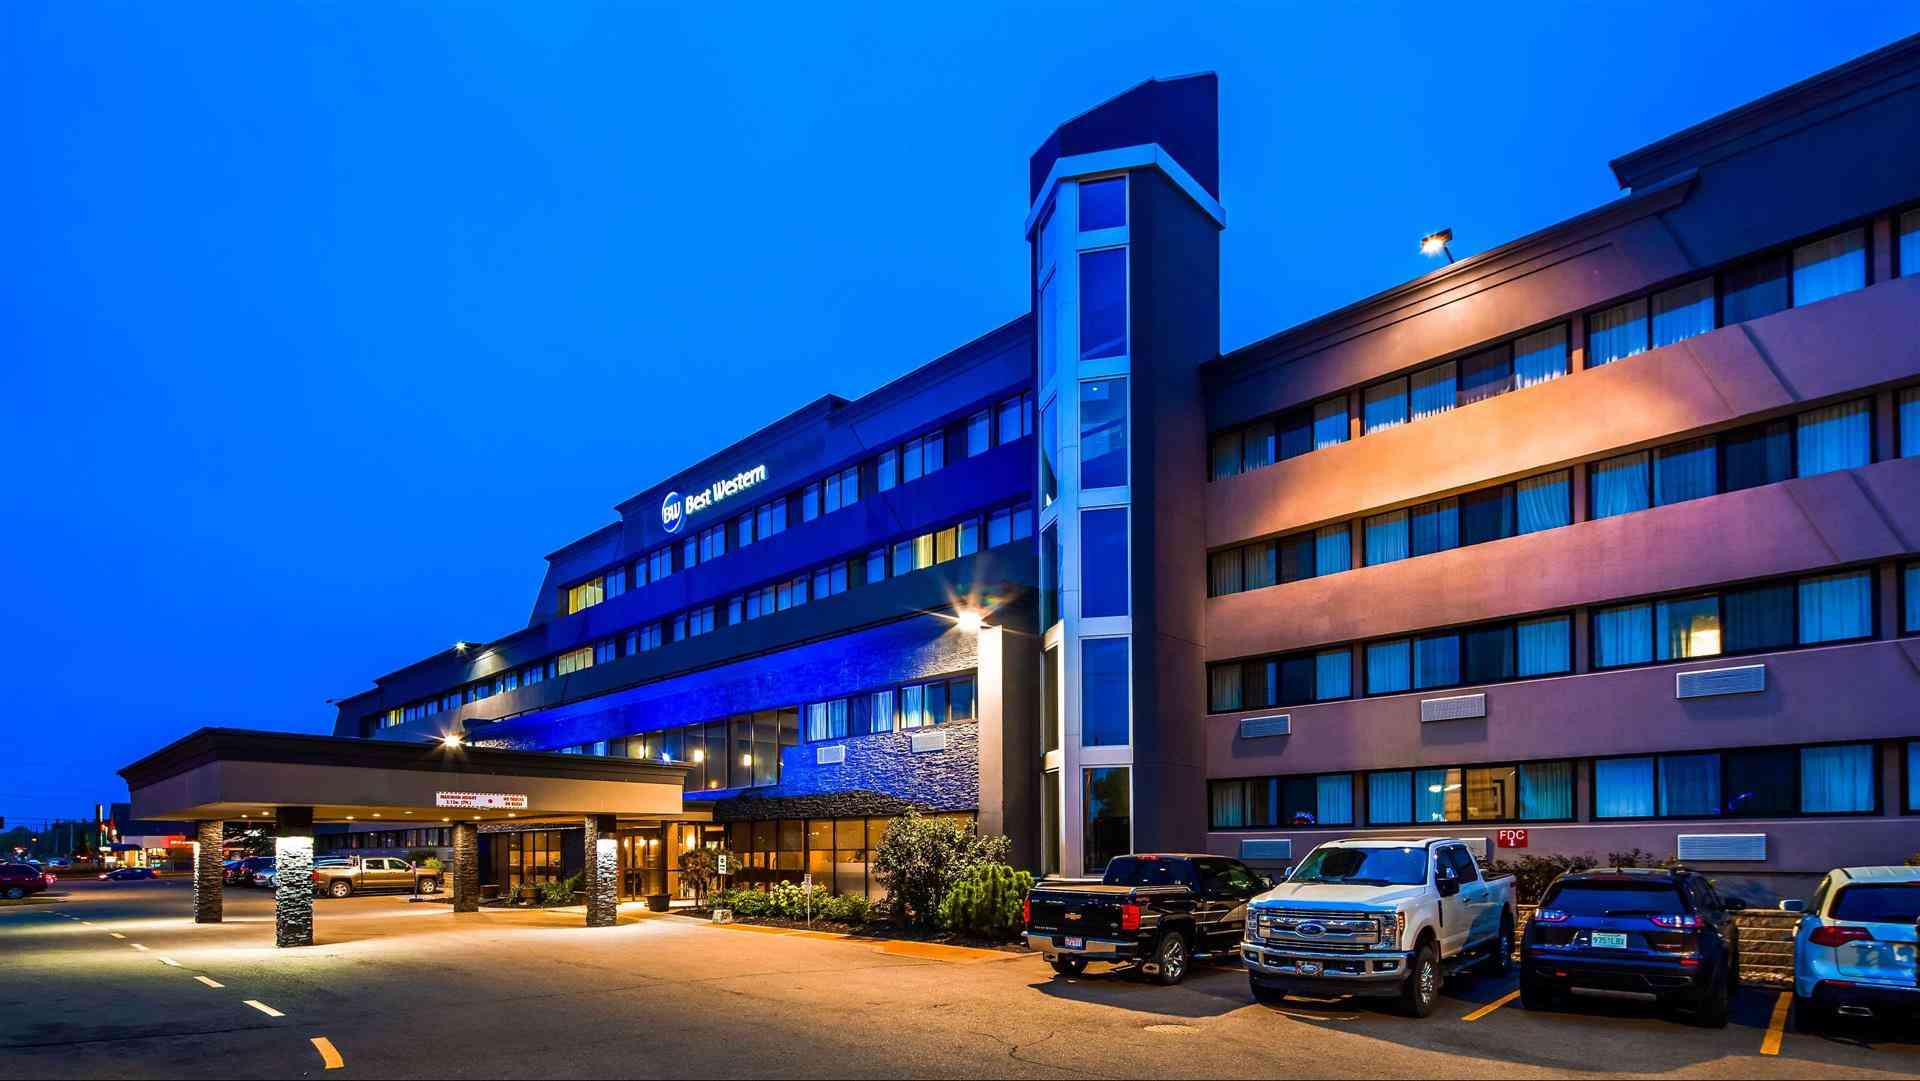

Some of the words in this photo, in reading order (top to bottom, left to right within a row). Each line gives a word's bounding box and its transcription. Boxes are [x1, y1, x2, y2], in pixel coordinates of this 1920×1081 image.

[685, 488, 711, 514] Best
[712, 464, 765, 501] Western
[663, 500, 681, 524] BW
[1500, 830, 1525, 840] FDC
